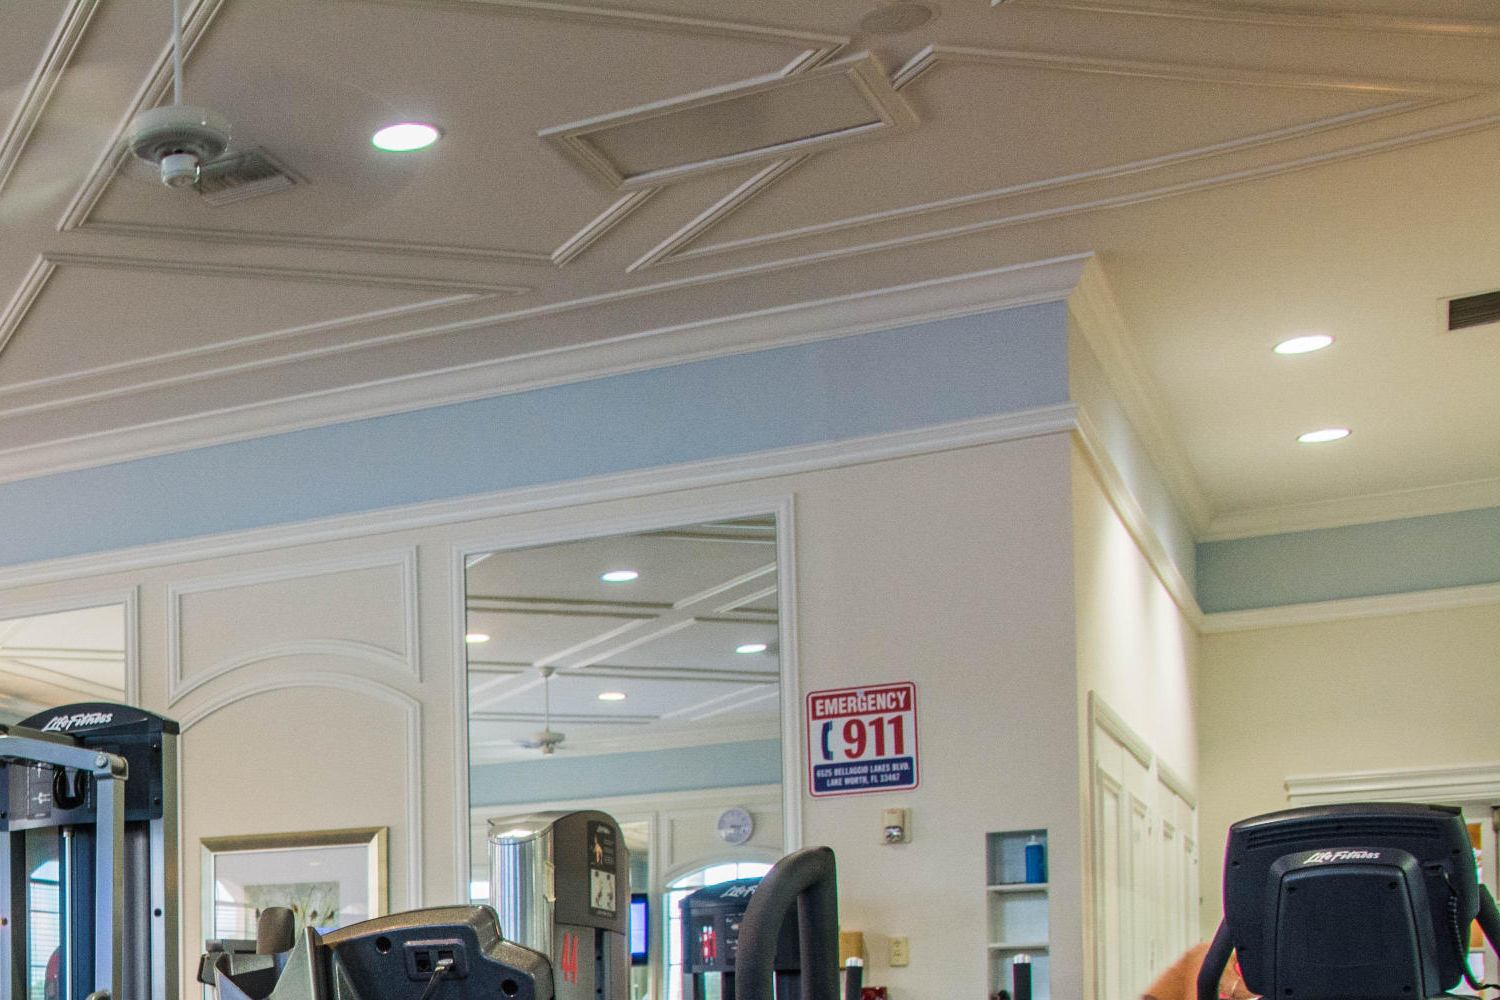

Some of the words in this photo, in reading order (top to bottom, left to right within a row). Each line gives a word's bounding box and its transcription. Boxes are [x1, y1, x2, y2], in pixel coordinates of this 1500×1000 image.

[815, 691, 907, 717] EMERGENCY
[842, 715, 904, 759] 911
[816, 768, 833, 778] 6525
[834, 765, 869, 776] BELLAGGIO
[870, 763, 891, 773] LAKES
[892, 762, 910, 771] BLVD.
[826, 778, 843, 787] LAKE
[871, 775, 878, 783] FL
[880, 773, 901, 783] 33467
[561, 931, 579, 985] 44
